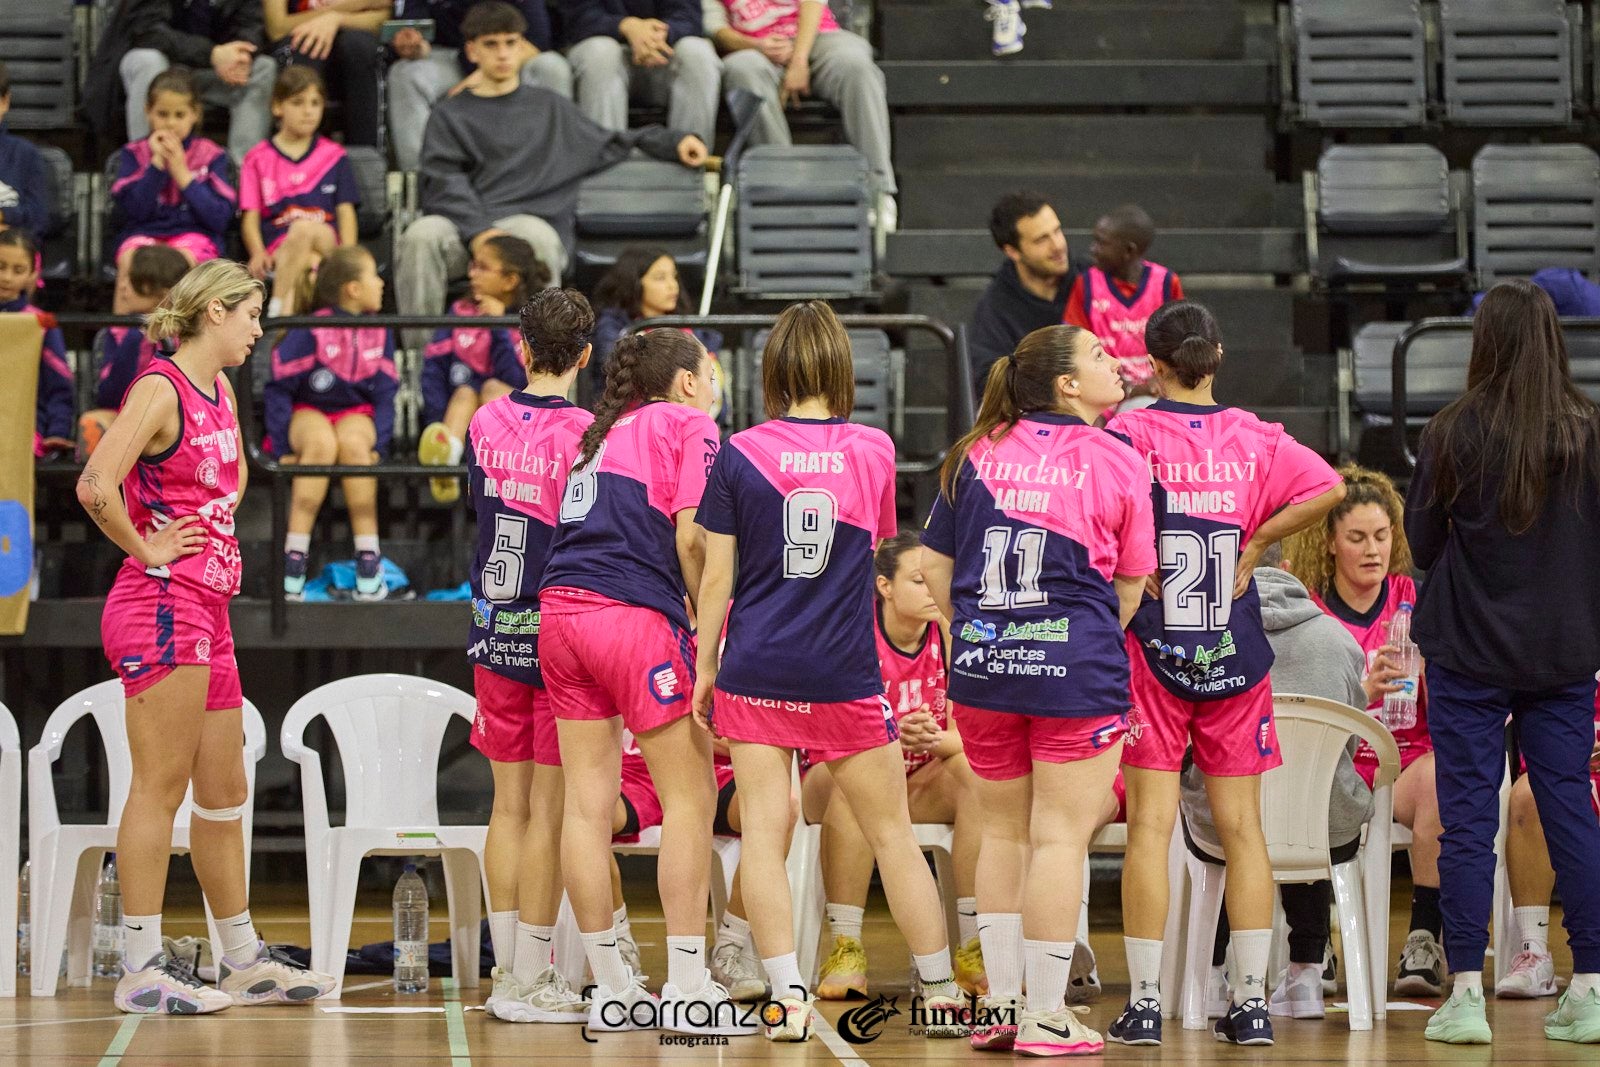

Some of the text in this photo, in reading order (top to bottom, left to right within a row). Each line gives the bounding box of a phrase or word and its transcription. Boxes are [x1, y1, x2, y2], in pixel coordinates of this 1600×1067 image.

[474, 436, 563, 480] fundavi
[780, 452, 844, 473] PRATS
[974, 449, 1090, 490] fundavi
[1146, 449, 1257, 484] fundavi
[484, 477, 498, 498] M.
[994, 487, 1051, 513] LAURI
[1166, 490, 1236, 514] RAMOS
[783, 487, 838, 579] 9
[481, 513, 529, 604] 5
[976, 525, 1049, 610] 11
[1159, 529, 1241, 632] 21
[494, 609, 541, 625] Asturia
[489, 636, 533, 654] Fuentes
[987, 645, 1046, 661] Fuentes
[489, 651, 503, 665] de
[987, 660, 1067, 677] de Invierno
